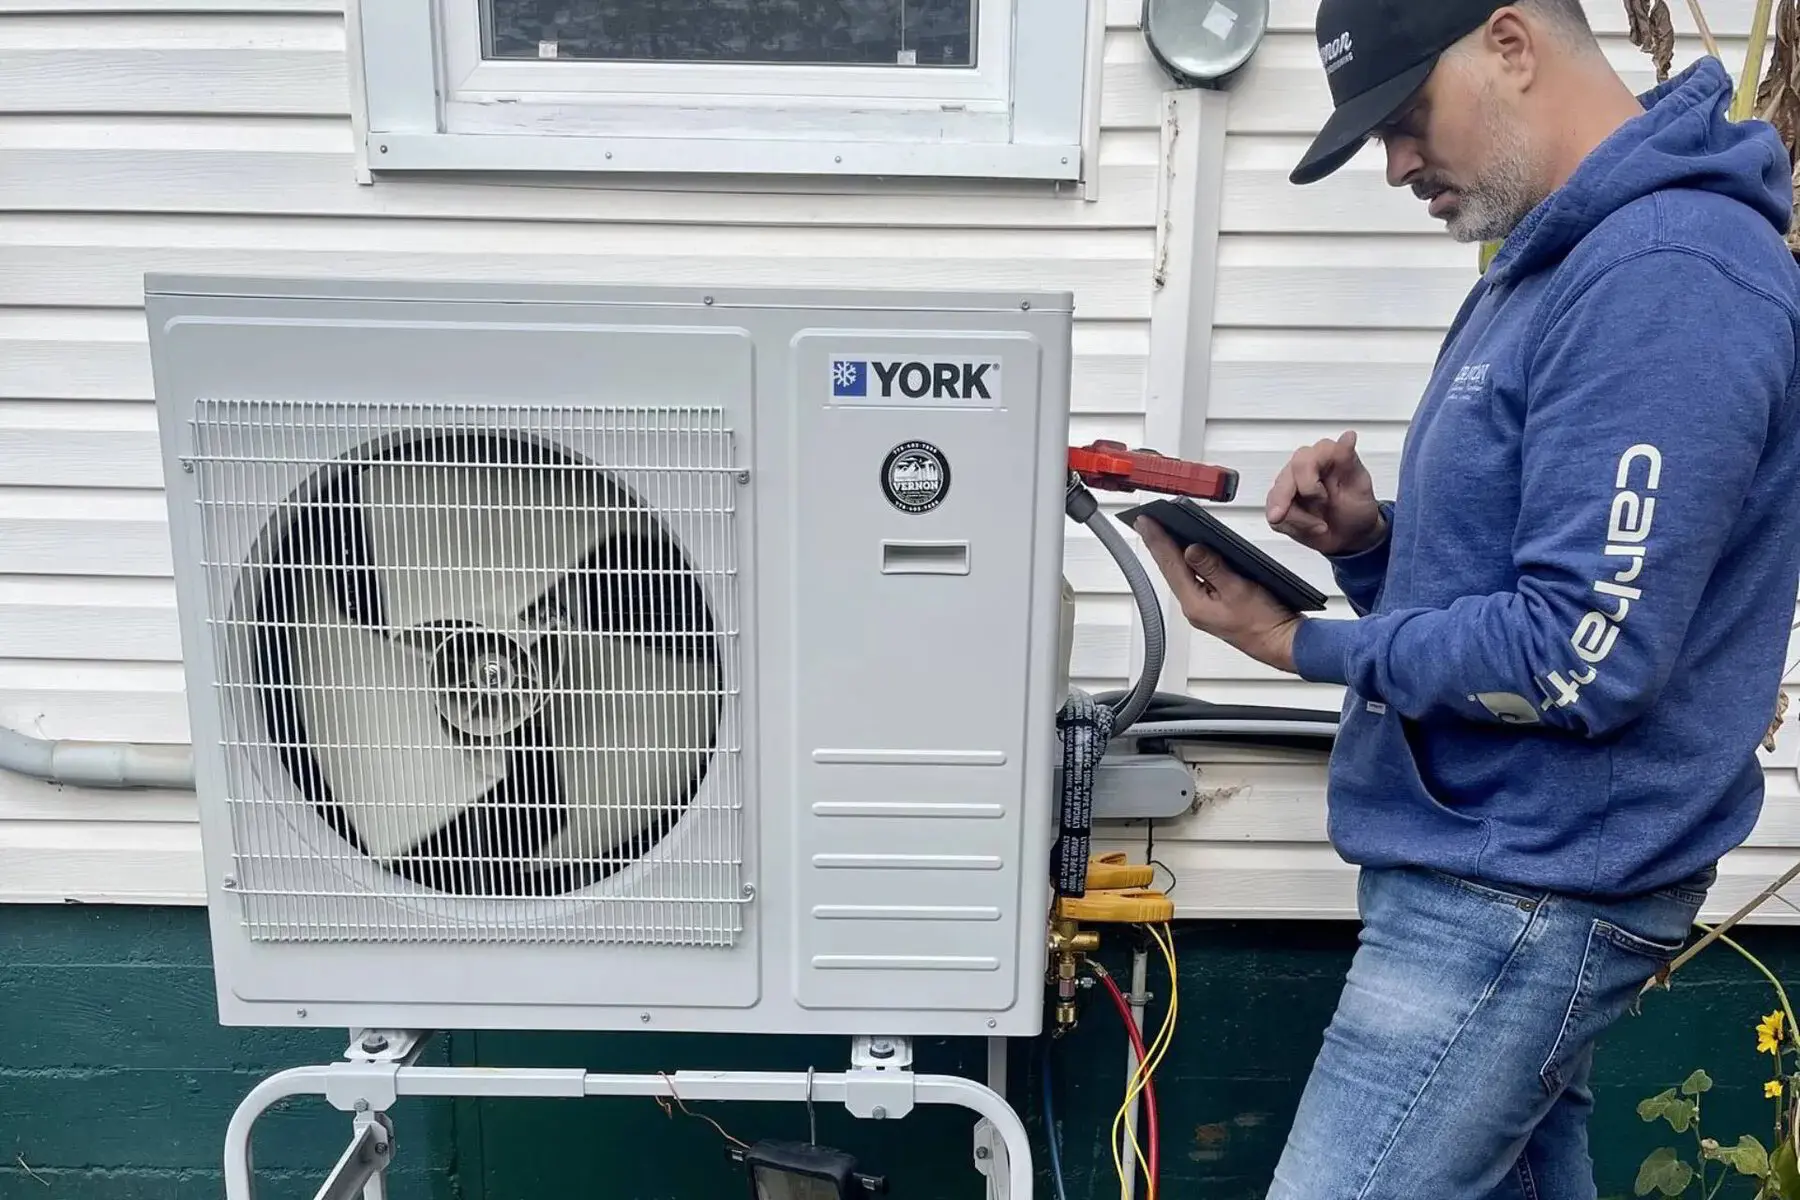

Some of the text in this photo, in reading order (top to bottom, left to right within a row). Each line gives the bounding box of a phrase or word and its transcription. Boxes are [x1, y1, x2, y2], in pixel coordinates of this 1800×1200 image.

[871, 361, 992, 399] YORK
[893, 481, 938, 491] VERNON
[1083, 753, 1091, 768] PVC
[1074, 786, 1082, 801] PVC
[1082, 791, 1090, 807] PIPE
[1072, 801, 1081, 828] LYNCAR
[1071, 836, 1079, 857] WRAP
